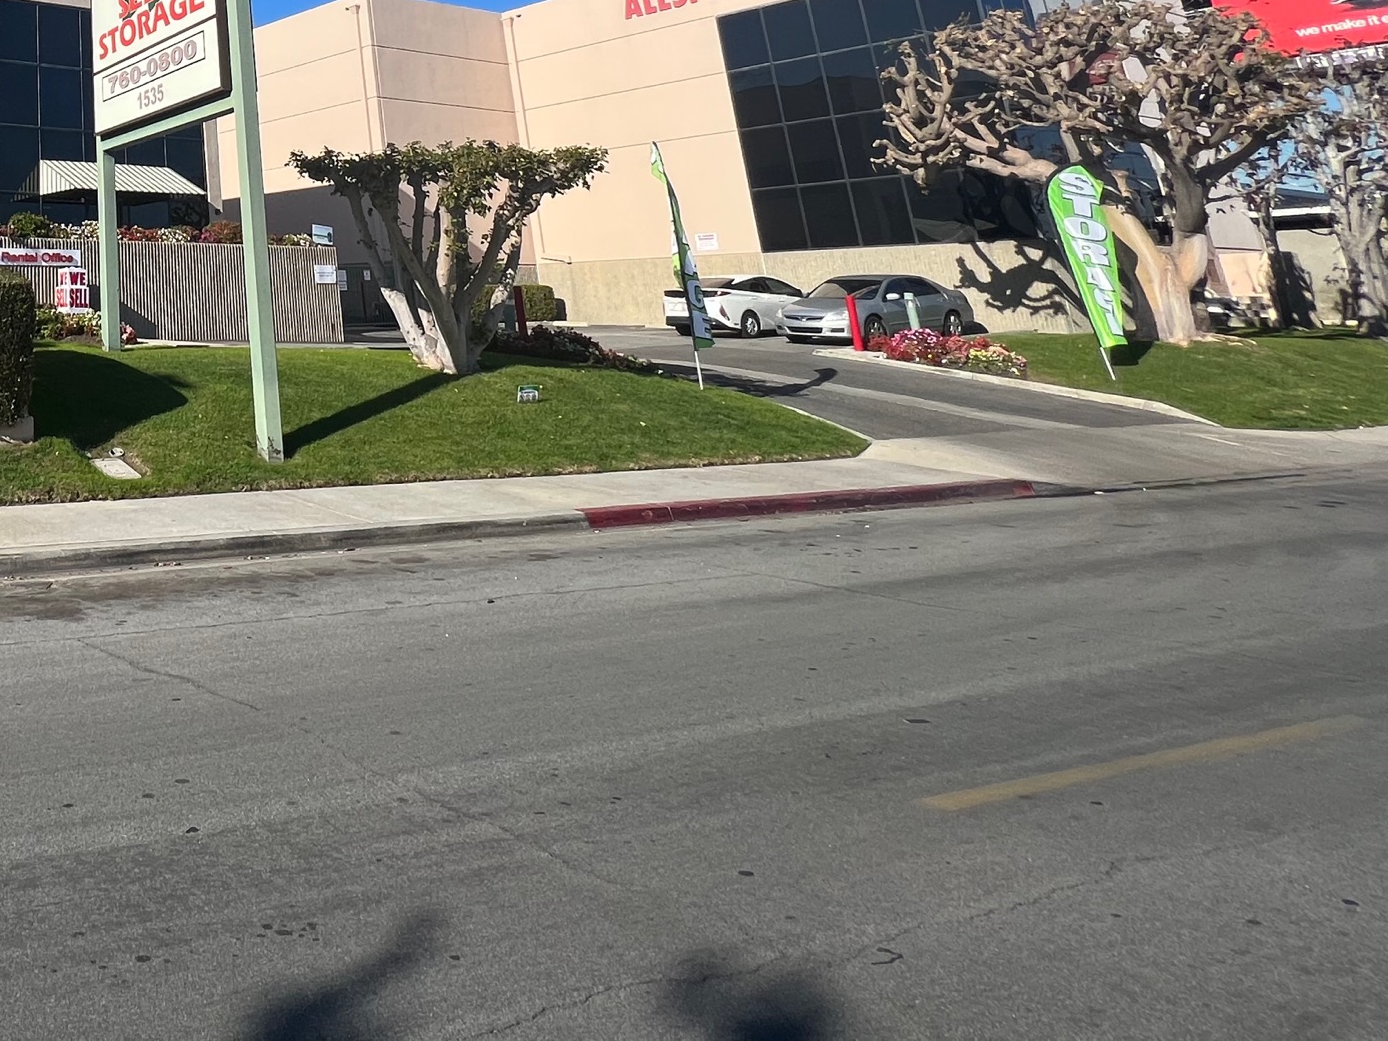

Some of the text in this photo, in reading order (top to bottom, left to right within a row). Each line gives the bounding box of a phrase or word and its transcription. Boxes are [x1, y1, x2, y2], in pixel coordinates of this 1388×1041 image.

[1295, 26, 1320, 37] we
[1321, 18, 1366, 33] make
[1366, 15, 1381, 26] it
[108, 39, 198, 94] 760-0800
[137, 83, 164, 109] 1535
[1, 251, 74, 263] Rental Office
[69, 271, 86, 285] WE
[69, 288, 89, 308] SELL
